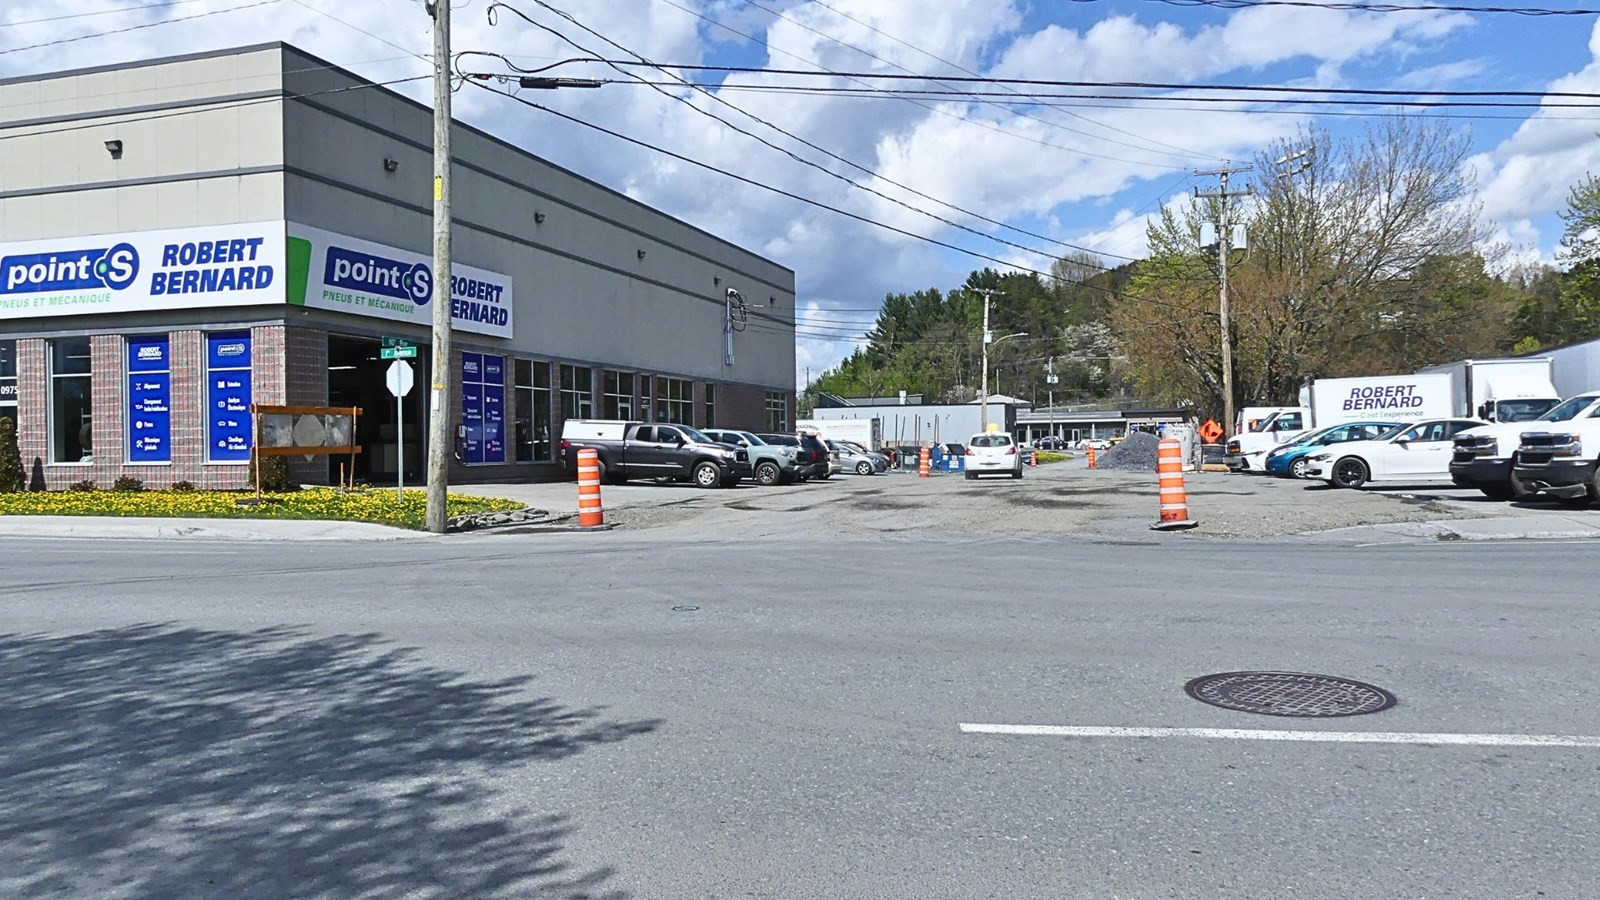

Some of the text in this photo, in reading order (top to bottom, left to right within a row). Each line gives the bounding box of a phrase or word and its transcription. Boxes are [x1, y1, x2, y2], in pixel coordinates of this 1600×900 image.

[162, 237, 264, 267] ROBERT
[7, 249, 134, 290] point S
[150, 265, 274, 296] BERNARD
[333, 258, 429, 298] point S
[33, 298, 47, 307] ET
[322, 290, 415, 314] PNEUS ET MÉCANIQUE
[451, 275, 503, 303] ROBERT
[451, 298, 508, 326] ERNARD
[1343, 396, 1423, 411] BERNARD
[1350, 385, 1416, 399] ROBERT
